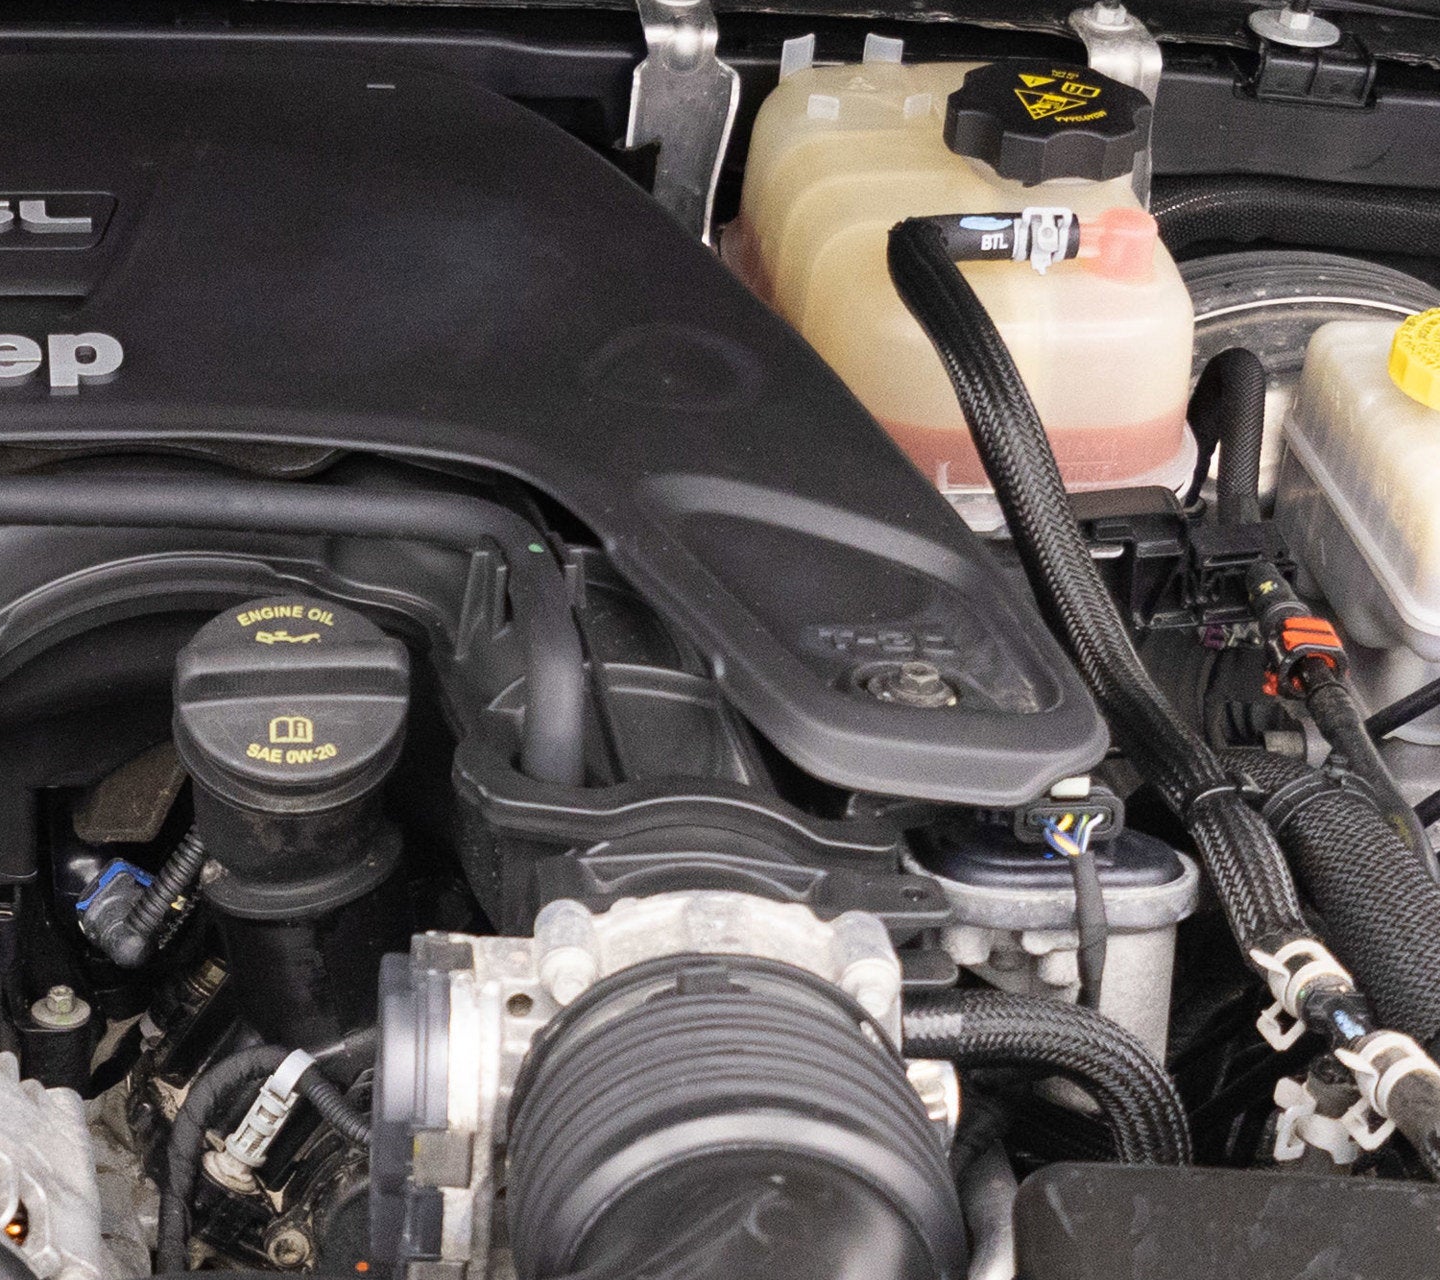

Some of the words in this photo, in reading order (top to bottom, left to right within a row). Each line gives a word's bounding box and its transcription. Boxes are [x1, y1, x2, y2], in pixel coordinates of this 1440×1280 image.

[981, 233, 1009, 250] BTL
[237, 605, 304, 627] ENGINE
[307, 606, 336, 627] OIL
[246, 743, 281, 764] SAE
[286, 743, 338, 764] 0W-20
